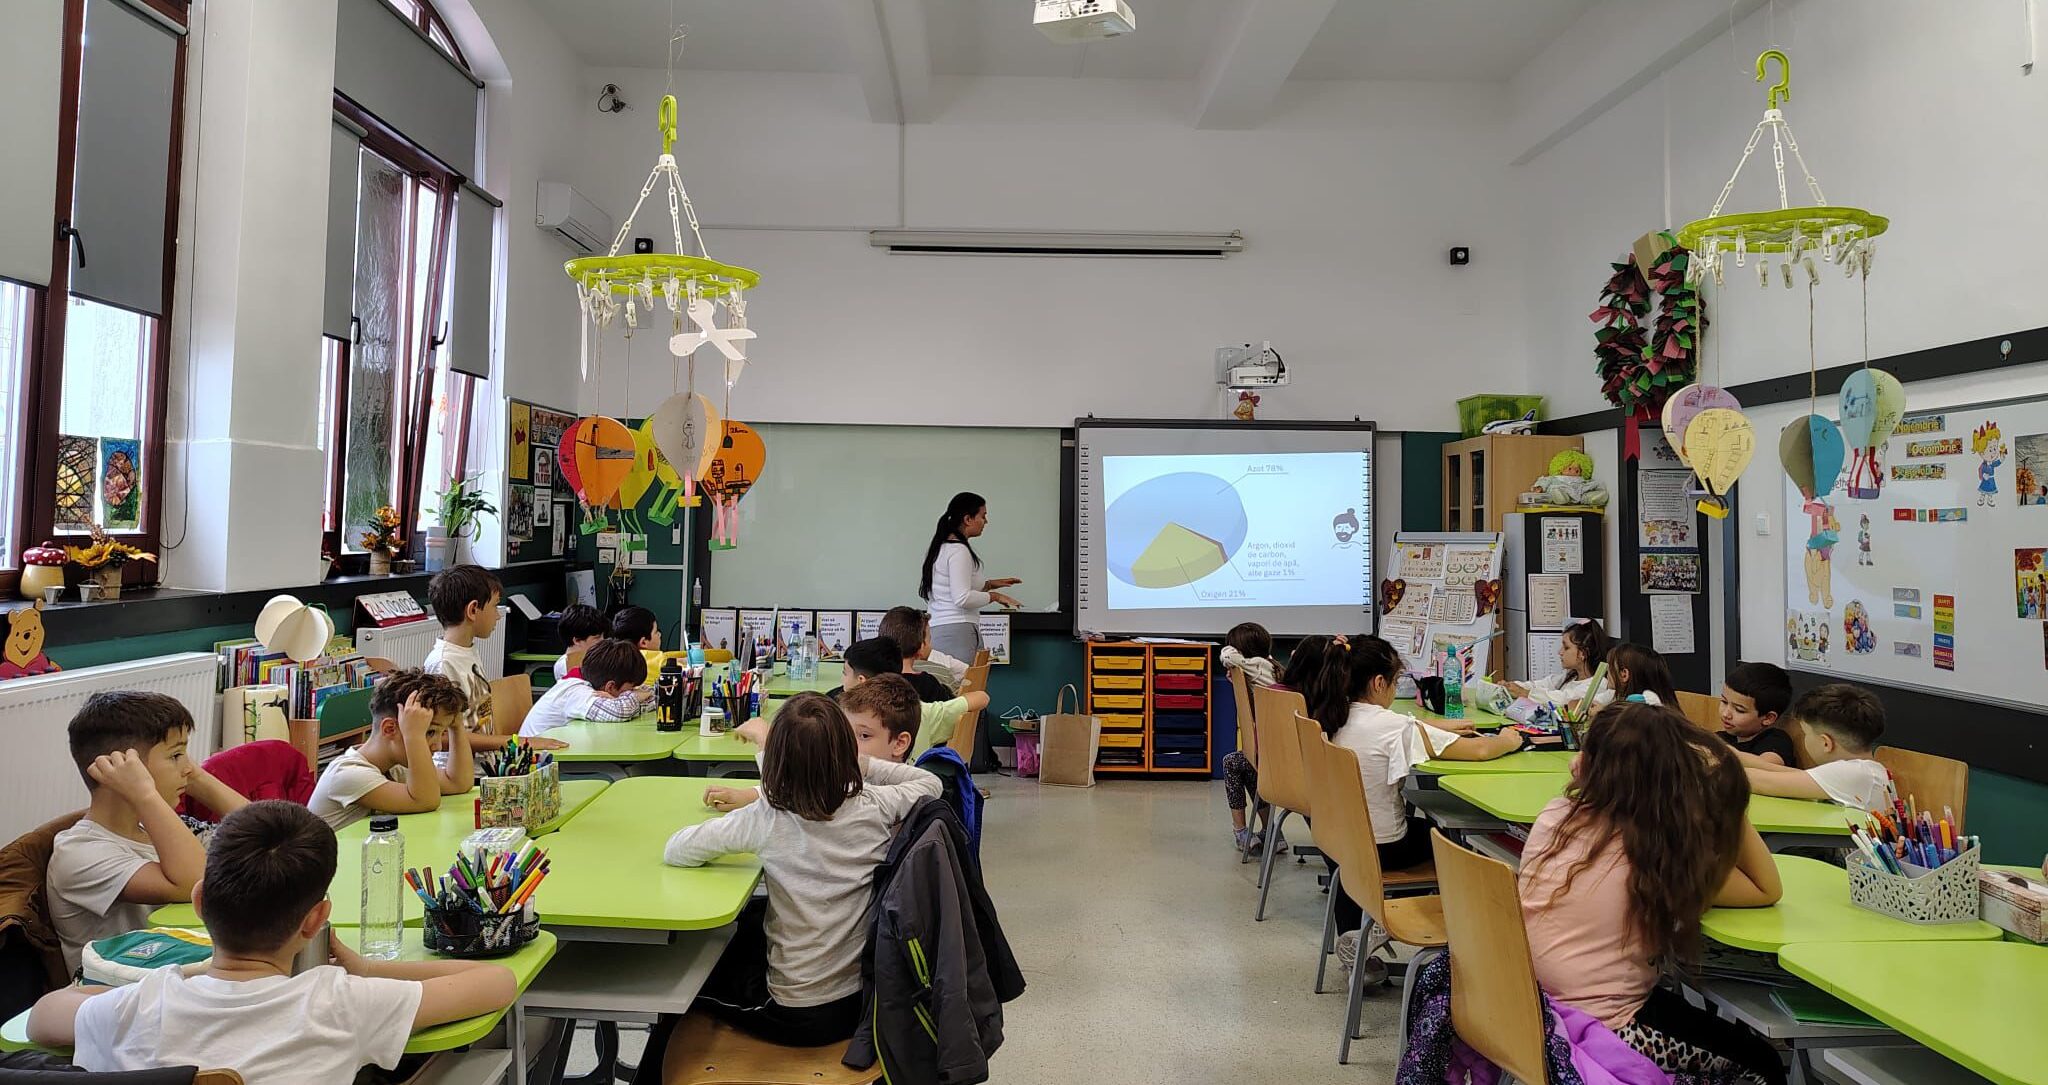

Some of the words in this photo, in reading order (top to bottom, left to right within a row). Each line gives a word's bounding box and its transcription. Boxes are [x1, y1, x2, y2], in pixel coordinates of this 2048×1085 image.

[1912, 444, 1957, 455] Octombrie
[1247, 464, 1264, 472] Azot
[1266, 464, 1284, 472] 78%
[1247, 542, 1271, 550] Argon,
[1273, 541, 1296, 549] dioxid
[1259, 551, 1287, 559] carbon,
[1247, 560, 1270, 568] vapori
[1272, 559, 1282, 567] de
[1247, 569, 1263, 577] alte
[1263, 570, 1281, 578] gaze
[1201, 591, 1227, 599] Oxigen
